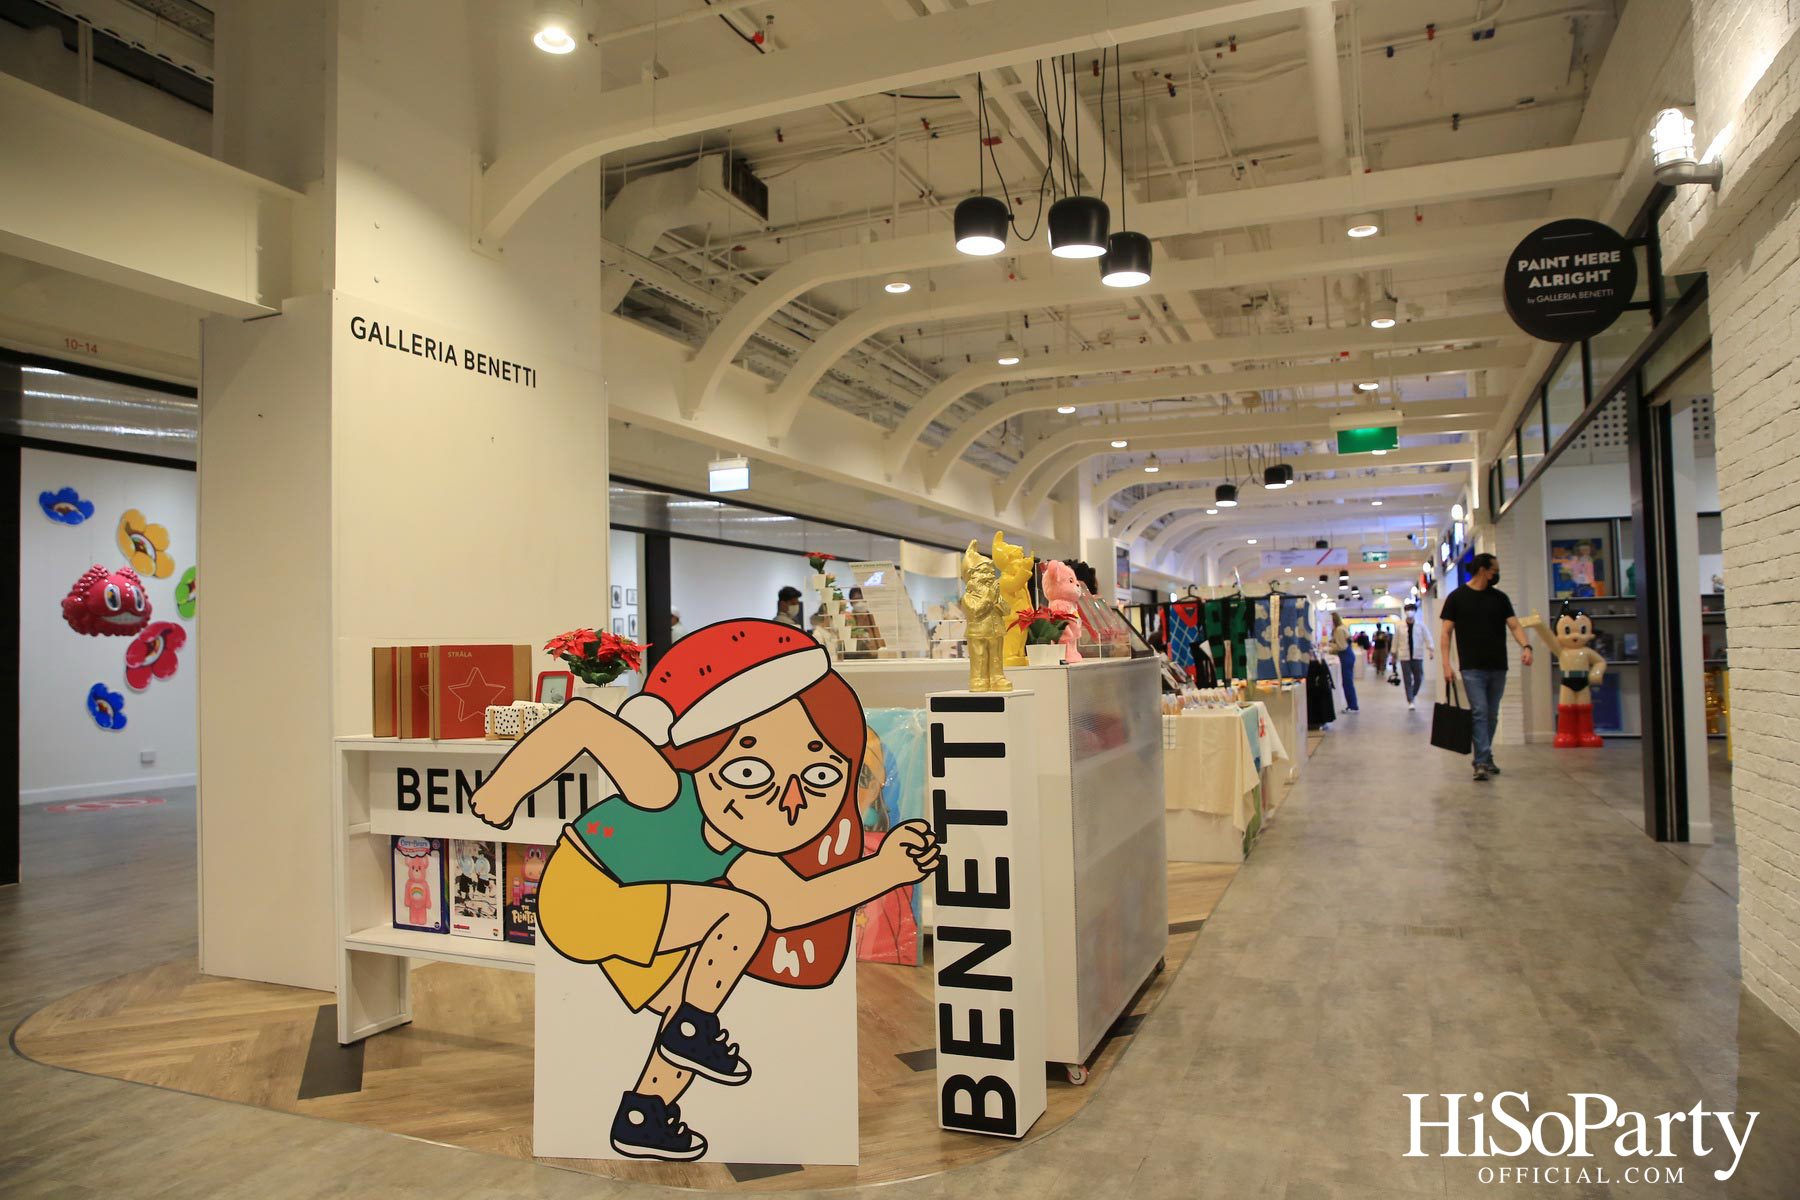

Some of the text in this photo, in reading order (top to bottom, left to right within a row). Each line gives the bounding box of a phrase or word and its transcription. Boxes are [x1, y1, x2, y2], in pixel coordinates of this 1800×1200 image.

[1518, 250, 1621, 272] PAINT HERE
[1528, 269, 1611, 289] ALRIGHT
[1527, 288, 1614, 304] by GALLERIA BENETTI
[64, 337, 98, 353] 10-14
[350, 316, 536, 389] GALLERIA BENETTI
[397, 767, 588, 819] BENTI
[930, 696, 1017, 1136] BENETTI
